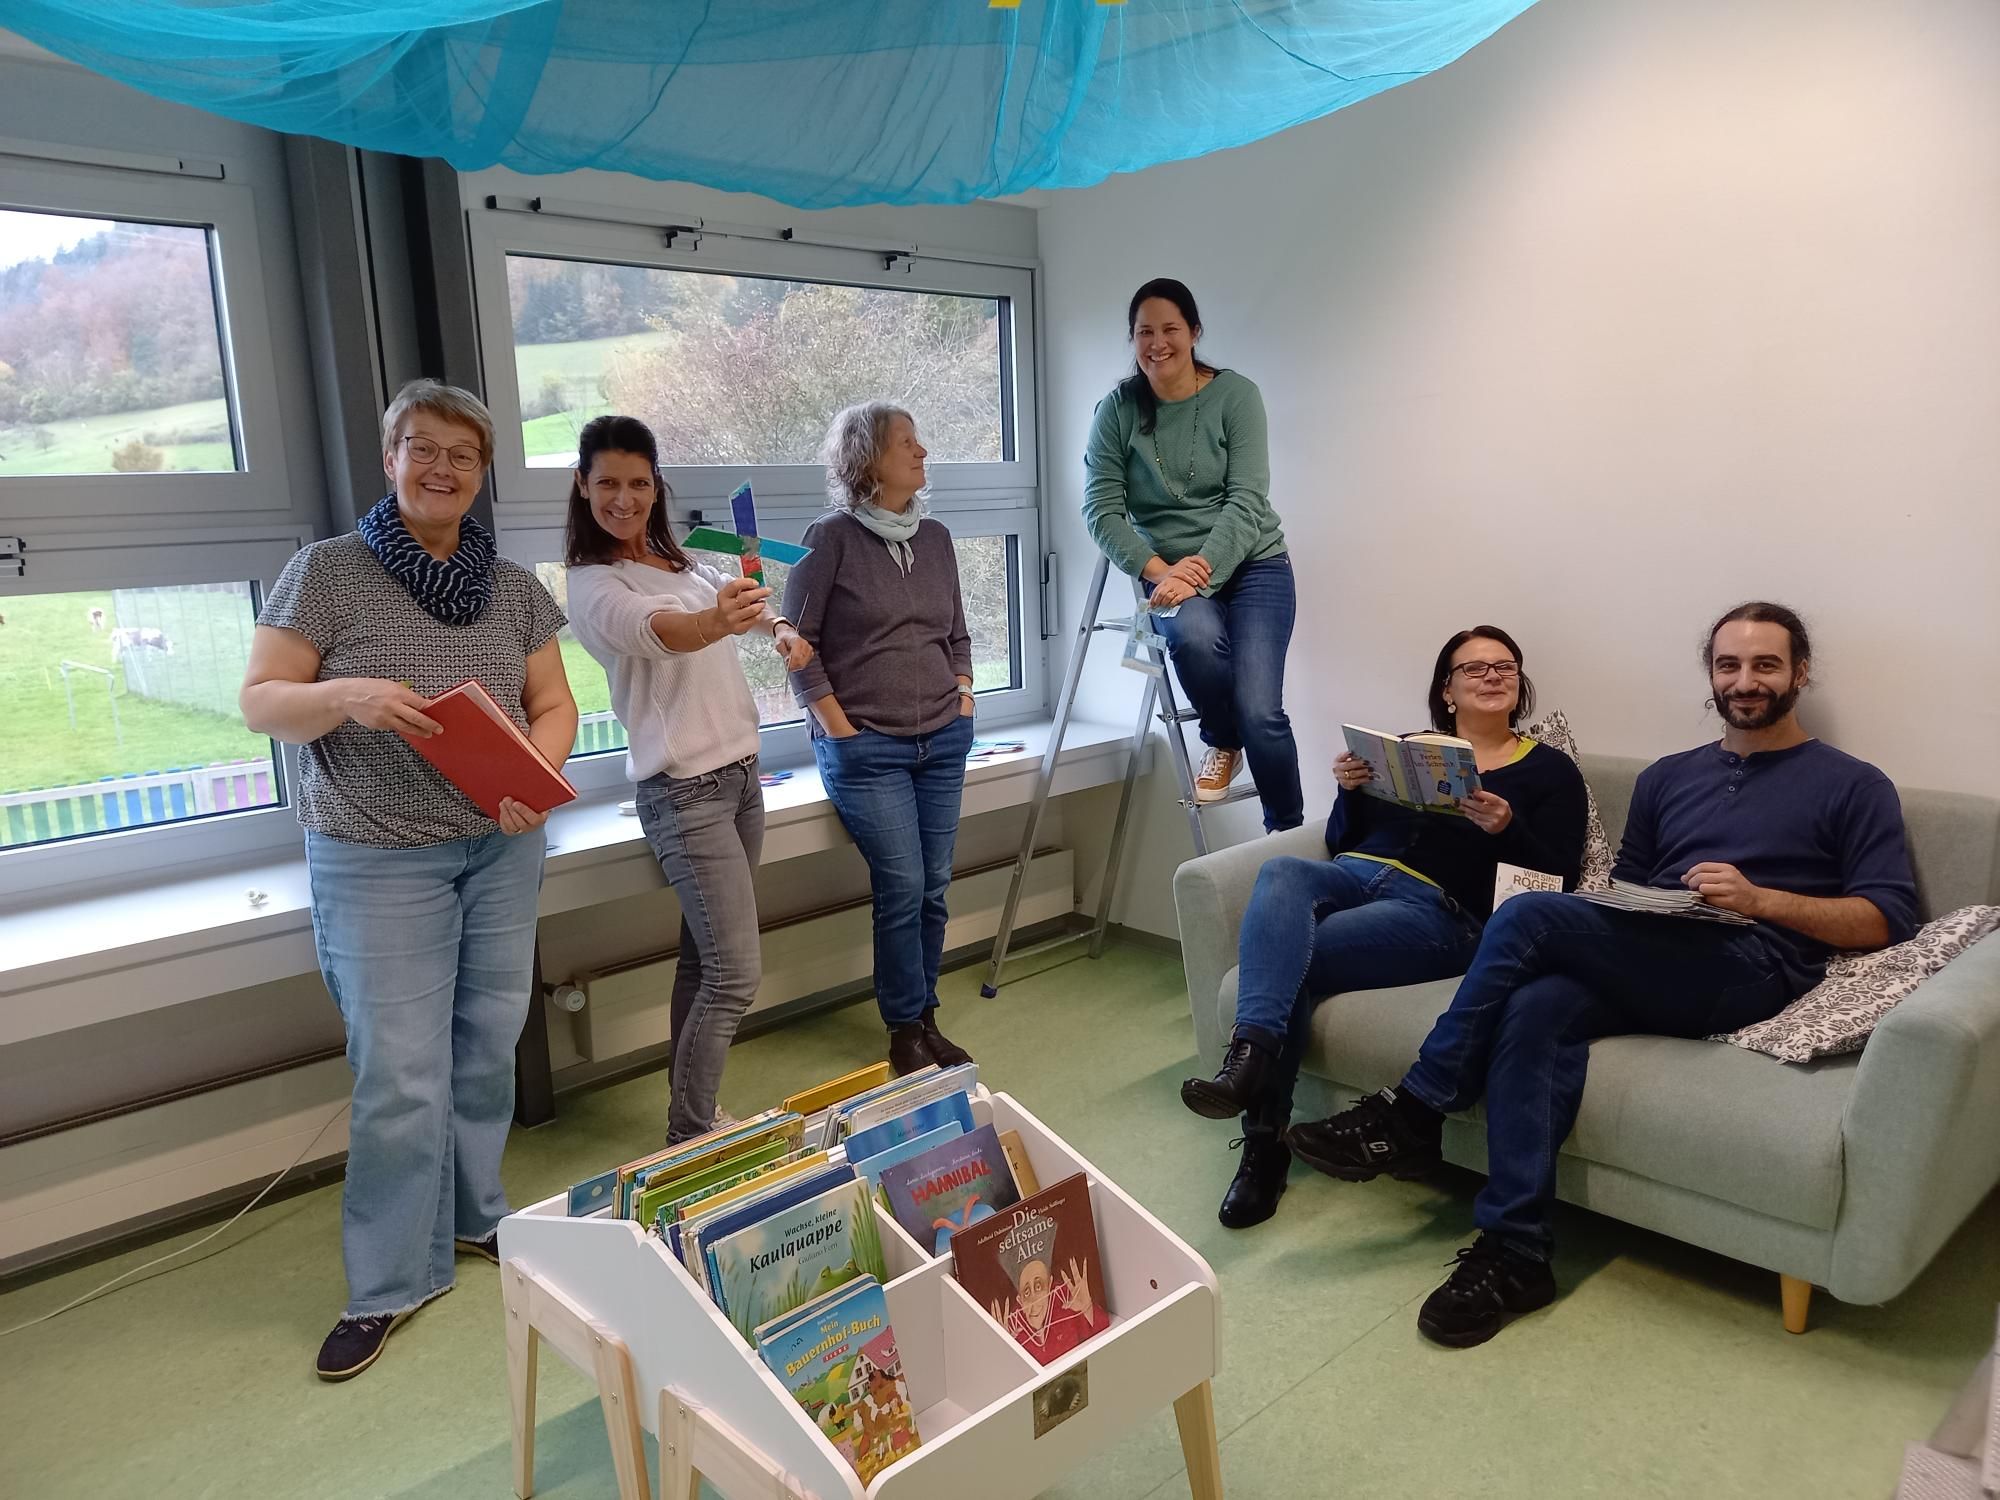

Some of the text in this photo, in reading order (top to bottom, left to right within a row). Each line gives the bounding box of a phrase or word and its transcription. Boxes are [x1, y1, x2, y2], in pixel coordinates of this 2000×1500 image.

[1523, 869, 1561, 884] WIR SIND
[911, 1158, 993, 1206] HANNIBAL
[784, 1208, 837, 1238] Wachse, kleine
[1012, 1206, 1040, 1229] Die
[750, 1219, 843, 1273] Kaulquappe
[998, 1216, 1054, 1253] seltsame
[1017, 1240, 1045, 1263] Alte
[820, 1320, 839, 1334] Mein
[785, 1314, 881, 1377] Bauernhof-Buch
